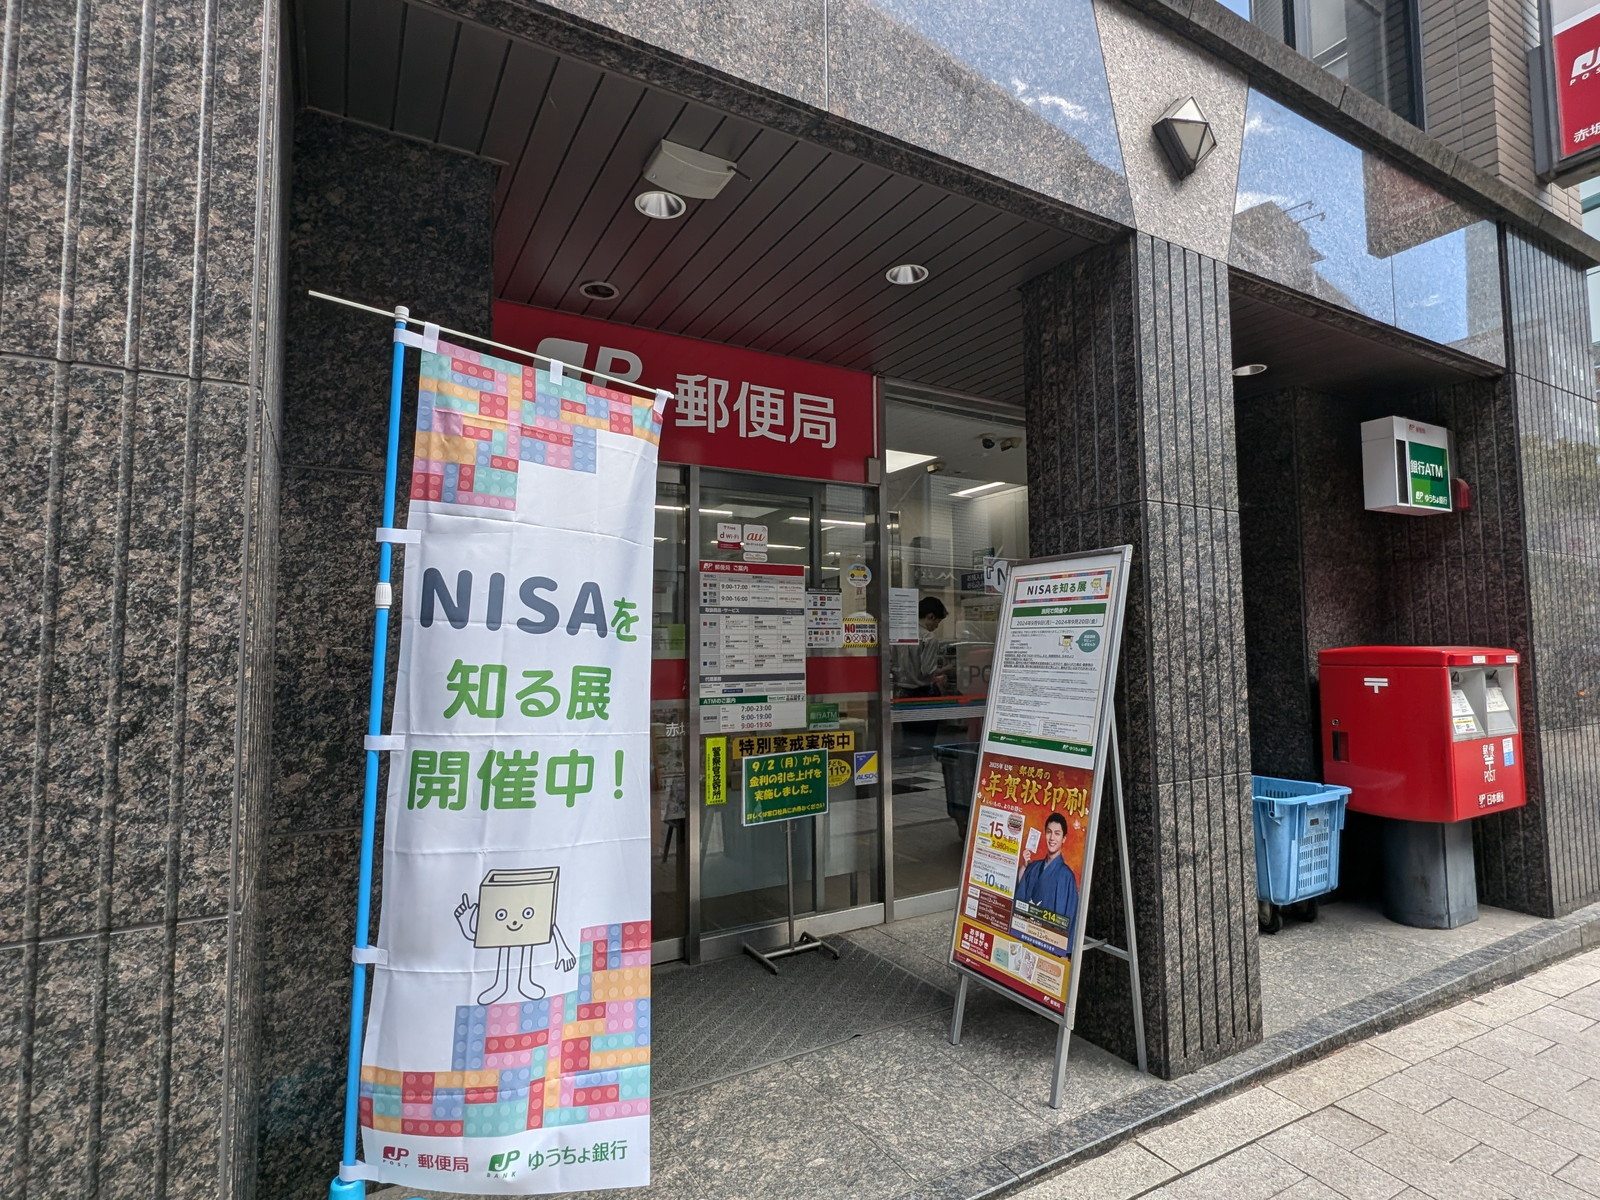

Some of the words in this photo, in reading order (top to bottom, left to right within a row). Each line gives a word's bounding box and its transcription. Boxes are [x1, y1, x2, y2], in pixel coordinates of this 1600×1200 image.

[674, 373, 837, 449] 郵便局
[1410, 459, 1443, 478] 銀行ATM
[1424, 493, 1448, 505] ゆうちょ銀行
[747, 532, 766, 542] au
[1026, 580, 1088, 596] NISAを知る展
[420, 567, 640, 642] NISAを
[443, 659, 612, 720] 知る展
[703, 697, 737, 705] ATMのご案内
[741, 704, 772, 712] 7:00-23:00
[741, 713, 772, 721] 9:00-19:00
[741, 721, 772, 729] 9:00-19:00
[739, 732, 851, 756] 特別警戒実施中
[1482, 743, 1495, 759] 郵便
[749, 768, 822, 787] 金利の引き上げを
[856, 773, 878, 781] ALSOK
[1018, 764, 1051, 780] 郵便局の
[1483, 769, 1496, 783] POST
[754, 784, 812, 801] 実施しました。
[984, 770, 1088, 818] 年賀状印刷
[417, 1153, 470, 1173] 郵便局
[528, 1140, 628, 1171] ゆうちょ銀行
[382, 1159, 410, 1169] POST
[486, 1170, 518, 1179] BANK
